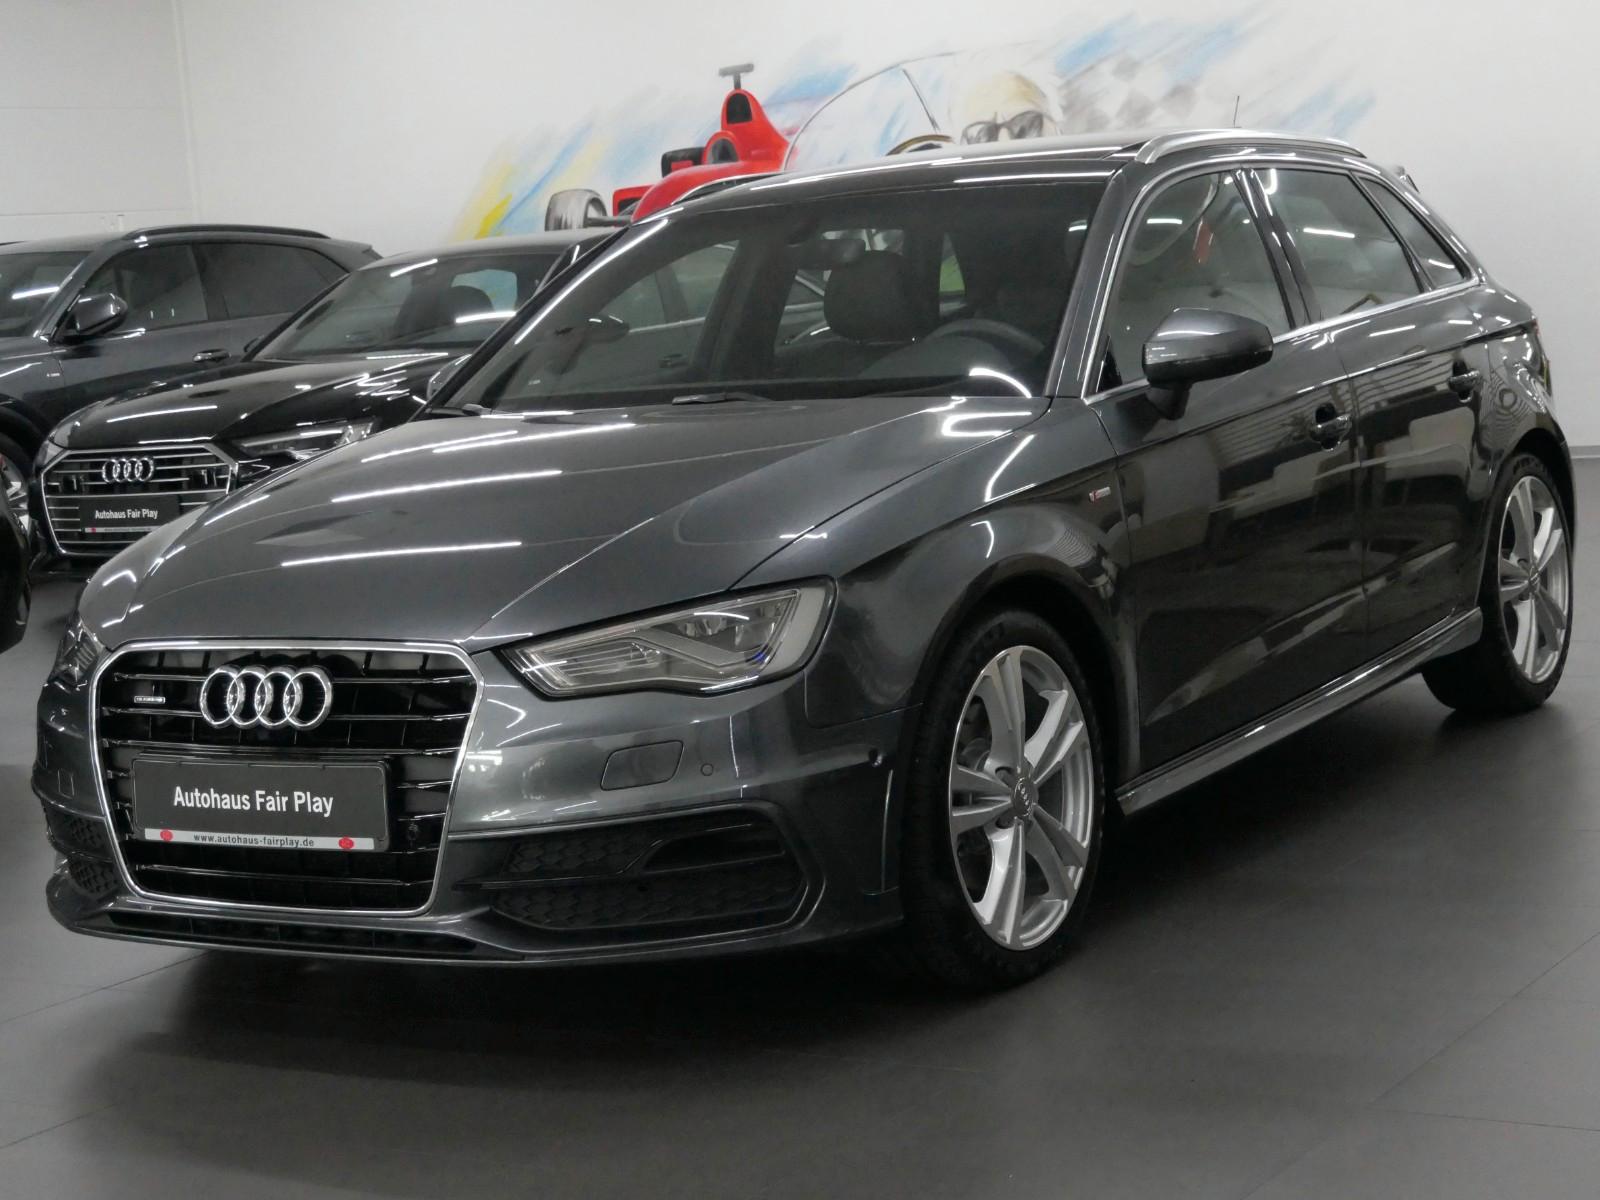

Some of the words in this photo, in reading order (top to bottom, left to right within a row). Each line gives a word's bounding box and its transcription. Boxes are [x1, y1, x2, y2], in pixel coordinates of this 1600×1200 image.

[95, 510, 126, 519] Autohaus
[127, 509, 140, 519] Fair
[142, 508, 158, 519] Play
[173, 786, 250, 810] Autohaus
[255, 790, 288, 812] Fair
[293, 791, 333, 817] Play
[193, 832, 314, 848] www.autohaus-fairplay.de
